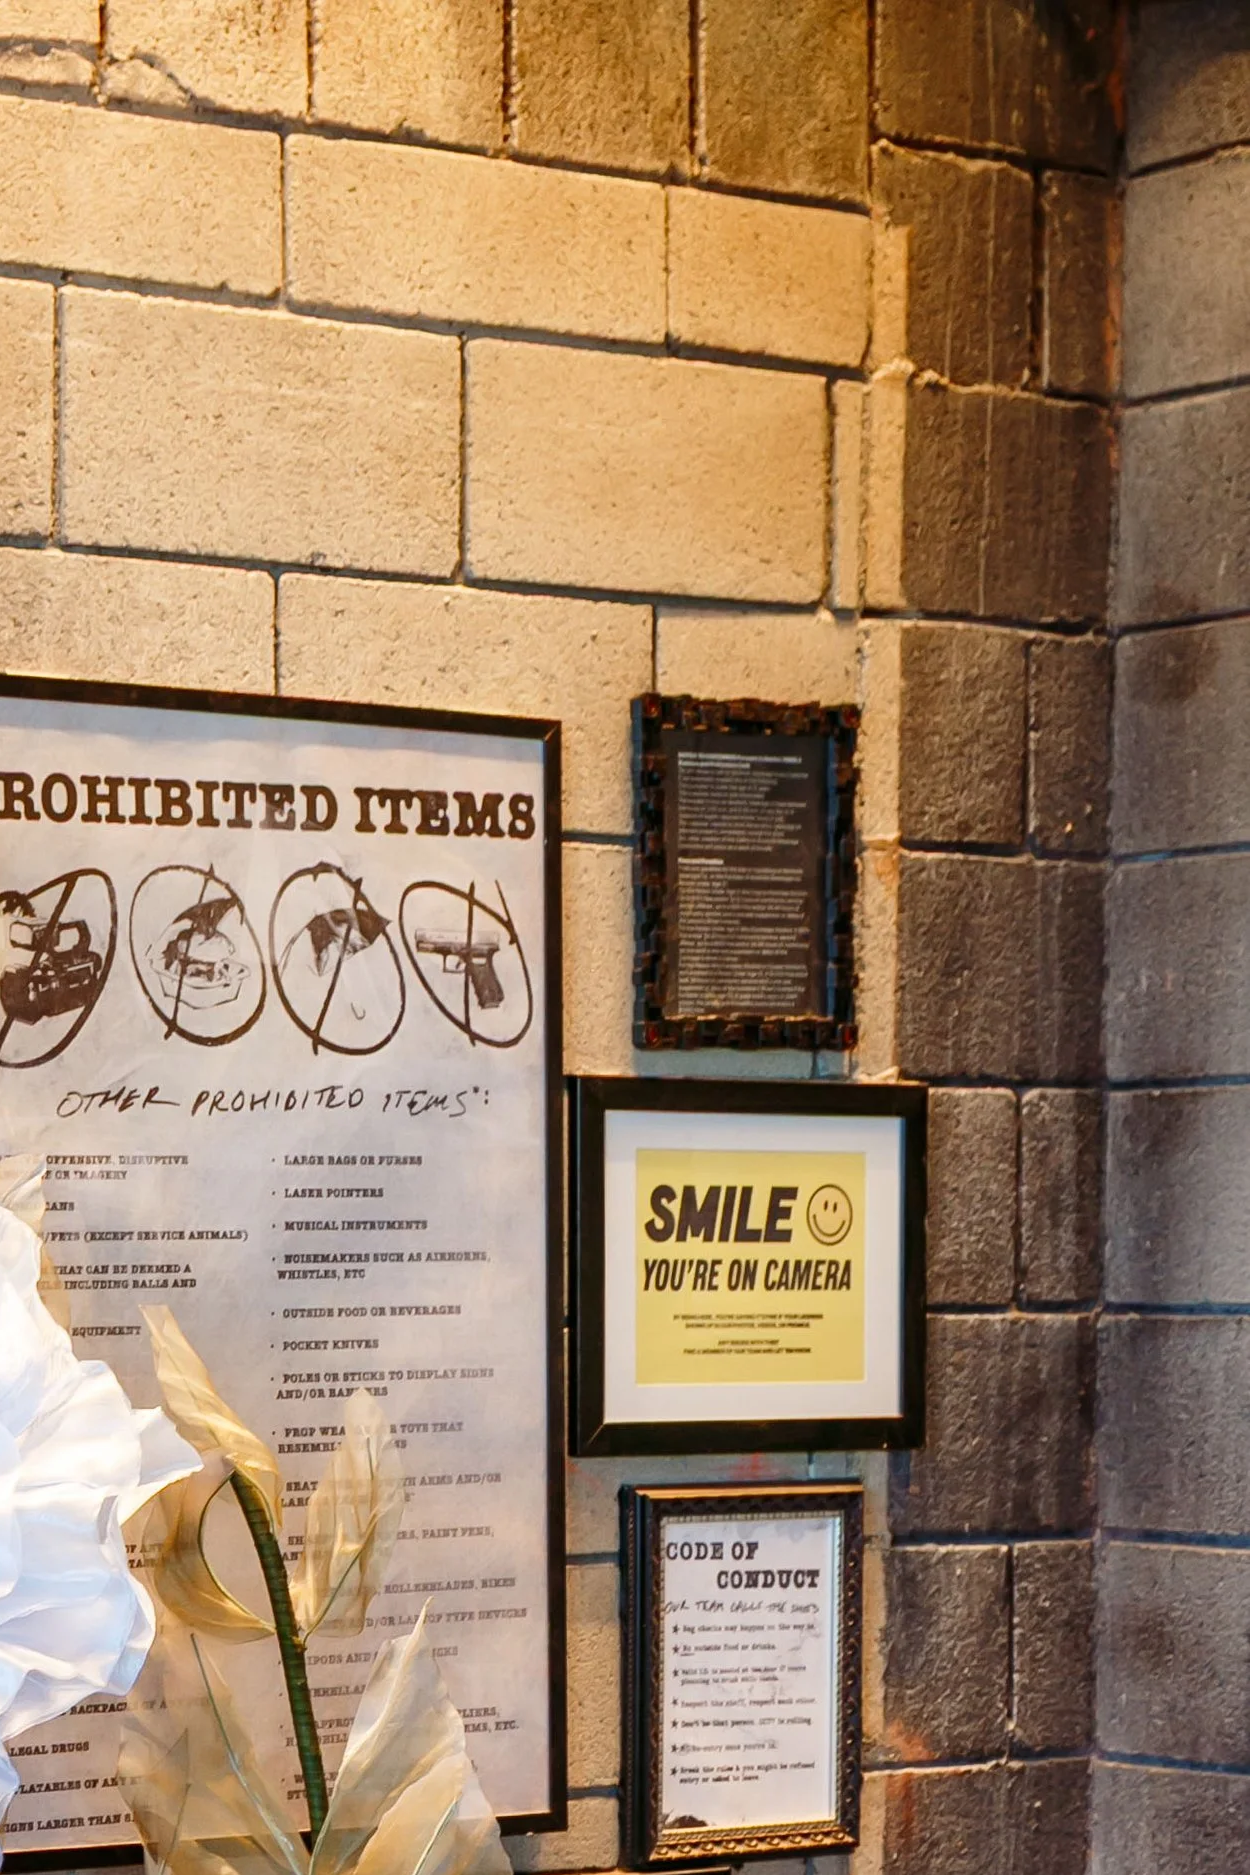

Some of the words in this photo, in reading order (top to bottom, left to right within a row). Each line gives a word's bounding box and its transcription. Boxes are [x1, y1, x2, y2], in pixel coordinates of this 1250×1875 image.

[354, 787, 537, 840] ITEMS
[57, 1086, 188, 1118] OTHER
[191, 1086, 365, 1116] PROHIBITED
[118, 1154, 188, 1166] DISRUPTIVE
[284, 1155, 324, 1166] LARGE
[327, 1155, 357, 1166] BAGS
[360, 1155, 375, 1166] OR
[378, 1155, 423, 1166] PURSES
[55, 1170, 70, 1180] OR
[284, 1188, 323, 1199] LASER
[326, 1188, 384, 1199] POINTERS
[644, 1184, 799, 1243] SMILE
[284, 1220, 339, 1231] MUSICAL
[341, 1220, 428, 1231] INSTRUMENTS
[83, 1230, 135, 1243] (EXCEPT
[137, 1230, 186, 1242] SERVICE
[188, 1229, 249, 1242] ANIMALS)
[284, 1253, 370, 1264] NOISEMAKERS
[373, 1253, 403, 1263] SUCH
[407, 1252, 422, 1262] AS
[53, 1265, 82, 1275] THAT
[85, 1265, 110, 1275] CAN
[112, 1265, 128, 1274] BE
[131, 1264, 181, 1274] DEEMED
[182, 1264, 192, 1274] A
[344, 1269, 366, 1280] ETC
[643, 1258, 723, 1291] YOU'RE
[727, 1258, 759, 1291] ON
[764, 1258, 852, 1291] CAMERA
[64, 1280, 129, 1290] INCLUDING
[132, 1279, 169, 1289] BALLS
[171, 1278, 197, 1288] AND
[283, 1307, 334, 1319] OUTSIDE
[337, 1307, 367, 1318] FOOD
[370, 1307, 386, 1317] OR
[390, 1305, 462, 1317] BEVERAGES
[71, 1326, 142, 1337] EQUIPMENT
[283, 1340, 329, 1351] POCKET
[332, 1339, 379, 1350] KNIVES
[283, 1373, 320, 1384] POLES
[323, 1372, 340, 1383] OR
[342, 1371, 385, 1382] STICKS
[388, 1371, 403, 1381] TO
[406, 1369, 457, 1380] DISPLAY
[460, 1368, 494, 1378] SIGNS
[276, 1388, 326, 1401] AND/OR
[432, 1422, 464, 1432] THAT
[419, 1475, 453, 1486] ARMS
[455, 1472, 501, 1486] AND/OR
[422, 1528, 457, 1539] PAINT
[666, 1542, 724, 1560] CODE
[731, 1541, 759, 1560] OF
[481, 1577, 515, 1588] BIKES
[717, 1569, 820, 1589] CONDUCT
[695, 1600, 724, 1612] TEAM
[446, 1611, 475, 1623] TYPE
[477, 1608, 527, 1620] DEVICES
[345, 1652, 371, 1664] AND
[52, 1741, 90, 1754] DRUGS
[84, 1778, 99, 1789] OF
[37, 1817, 85, 1830] LARGER
[87, 1814, 122, 1826] THAN
